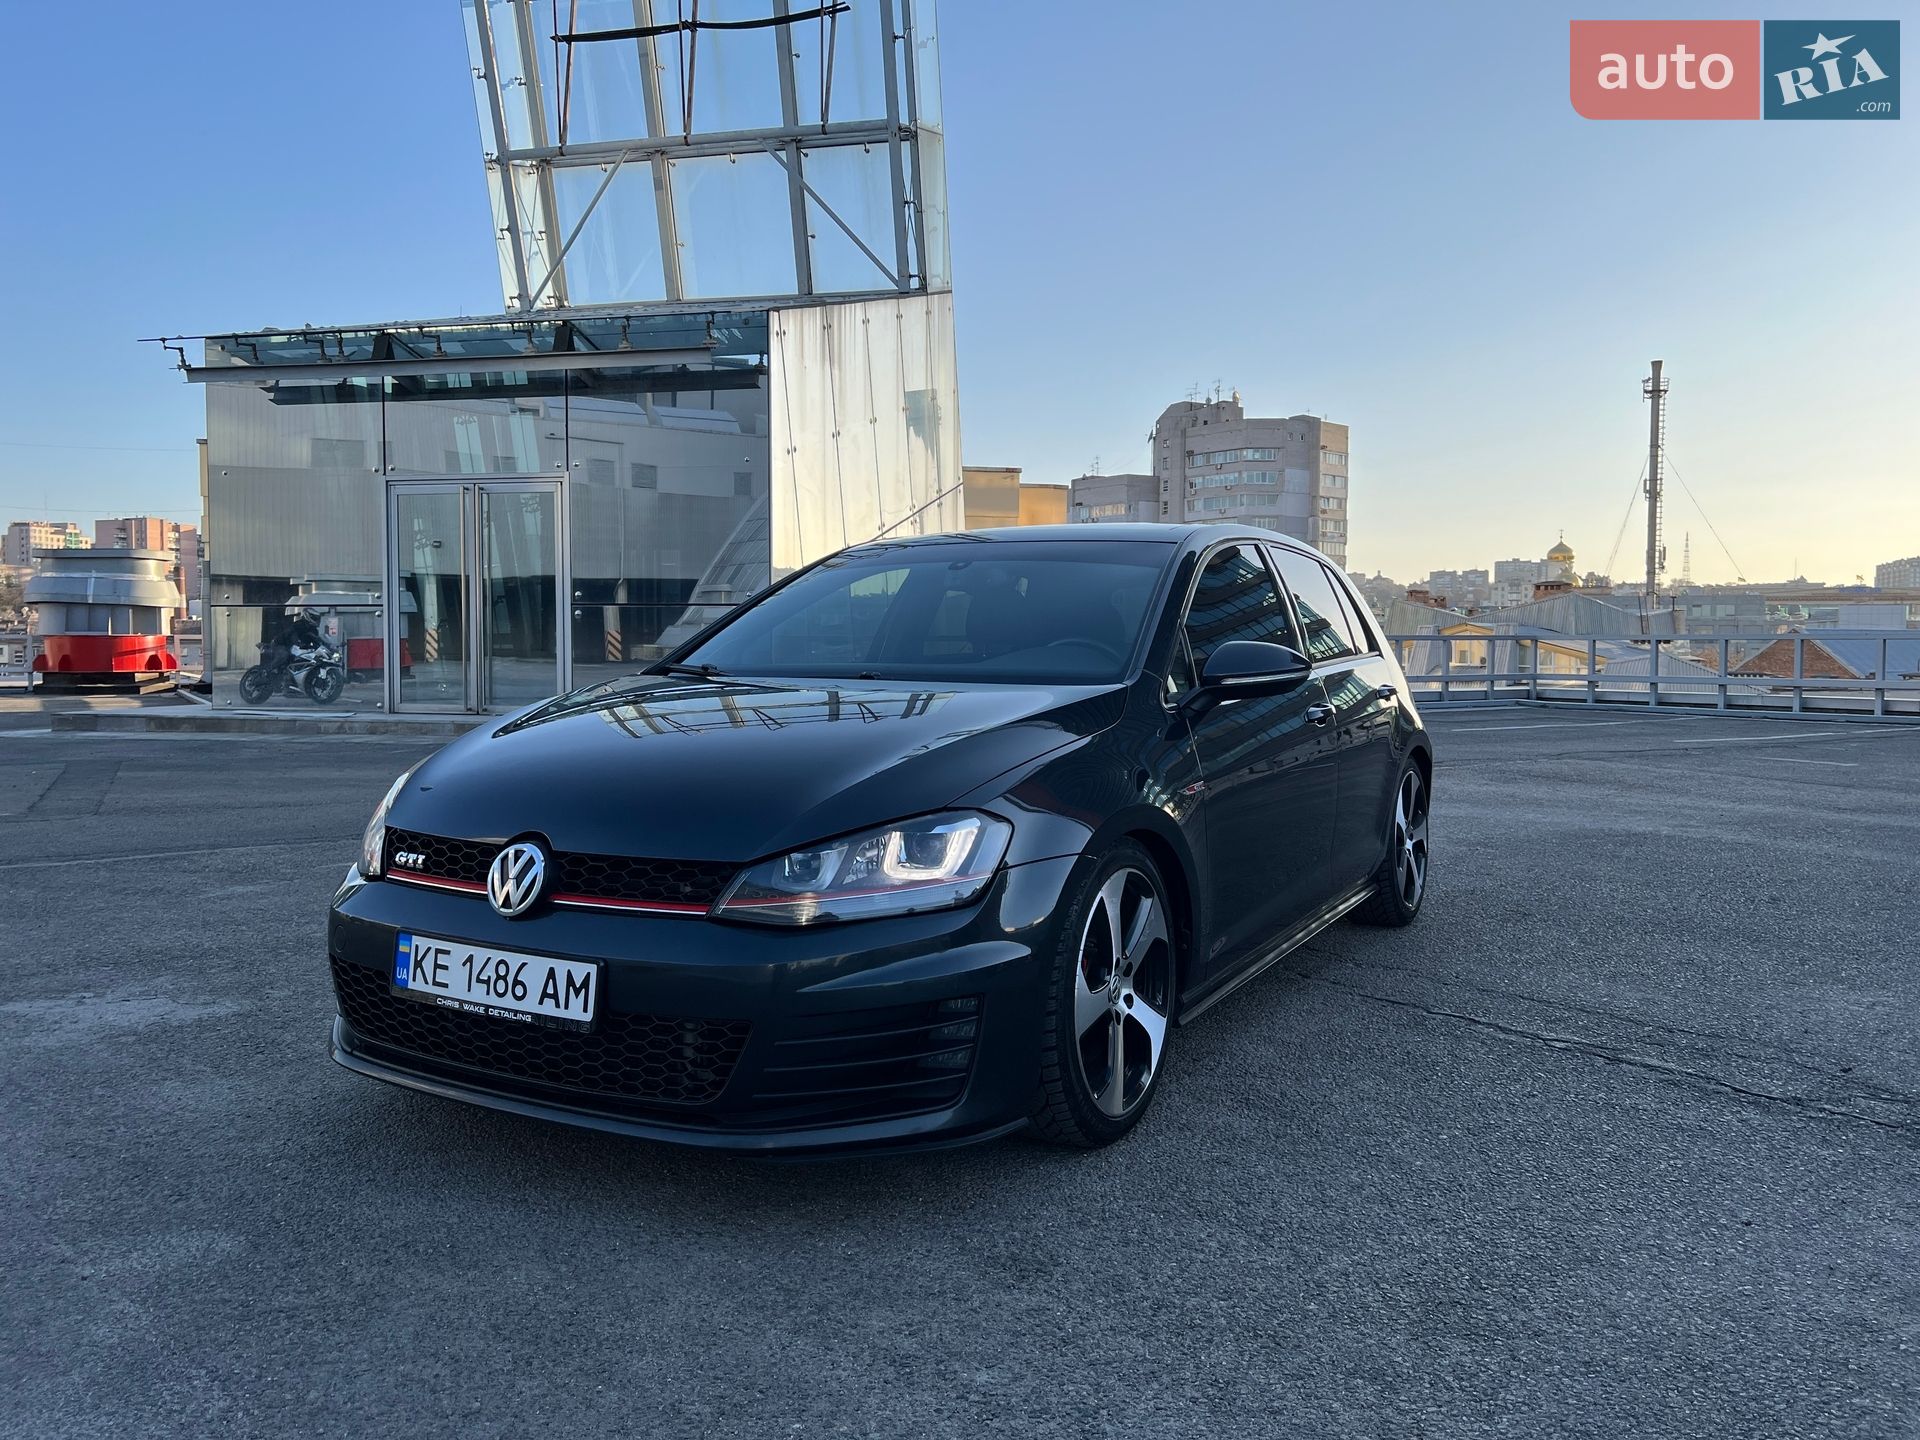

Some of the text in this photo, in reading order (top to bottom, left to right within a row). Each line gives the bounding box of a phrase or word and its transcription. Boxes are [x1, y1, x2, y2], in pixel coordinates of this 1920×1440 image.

[395, 851, 426, 869] GTI
[396, 967, 408, 980] UA
[412, 943, 592, 1014] KE 1486 AM
[436, 998, 532, 1022] CHRIS WAKE DETAILING
